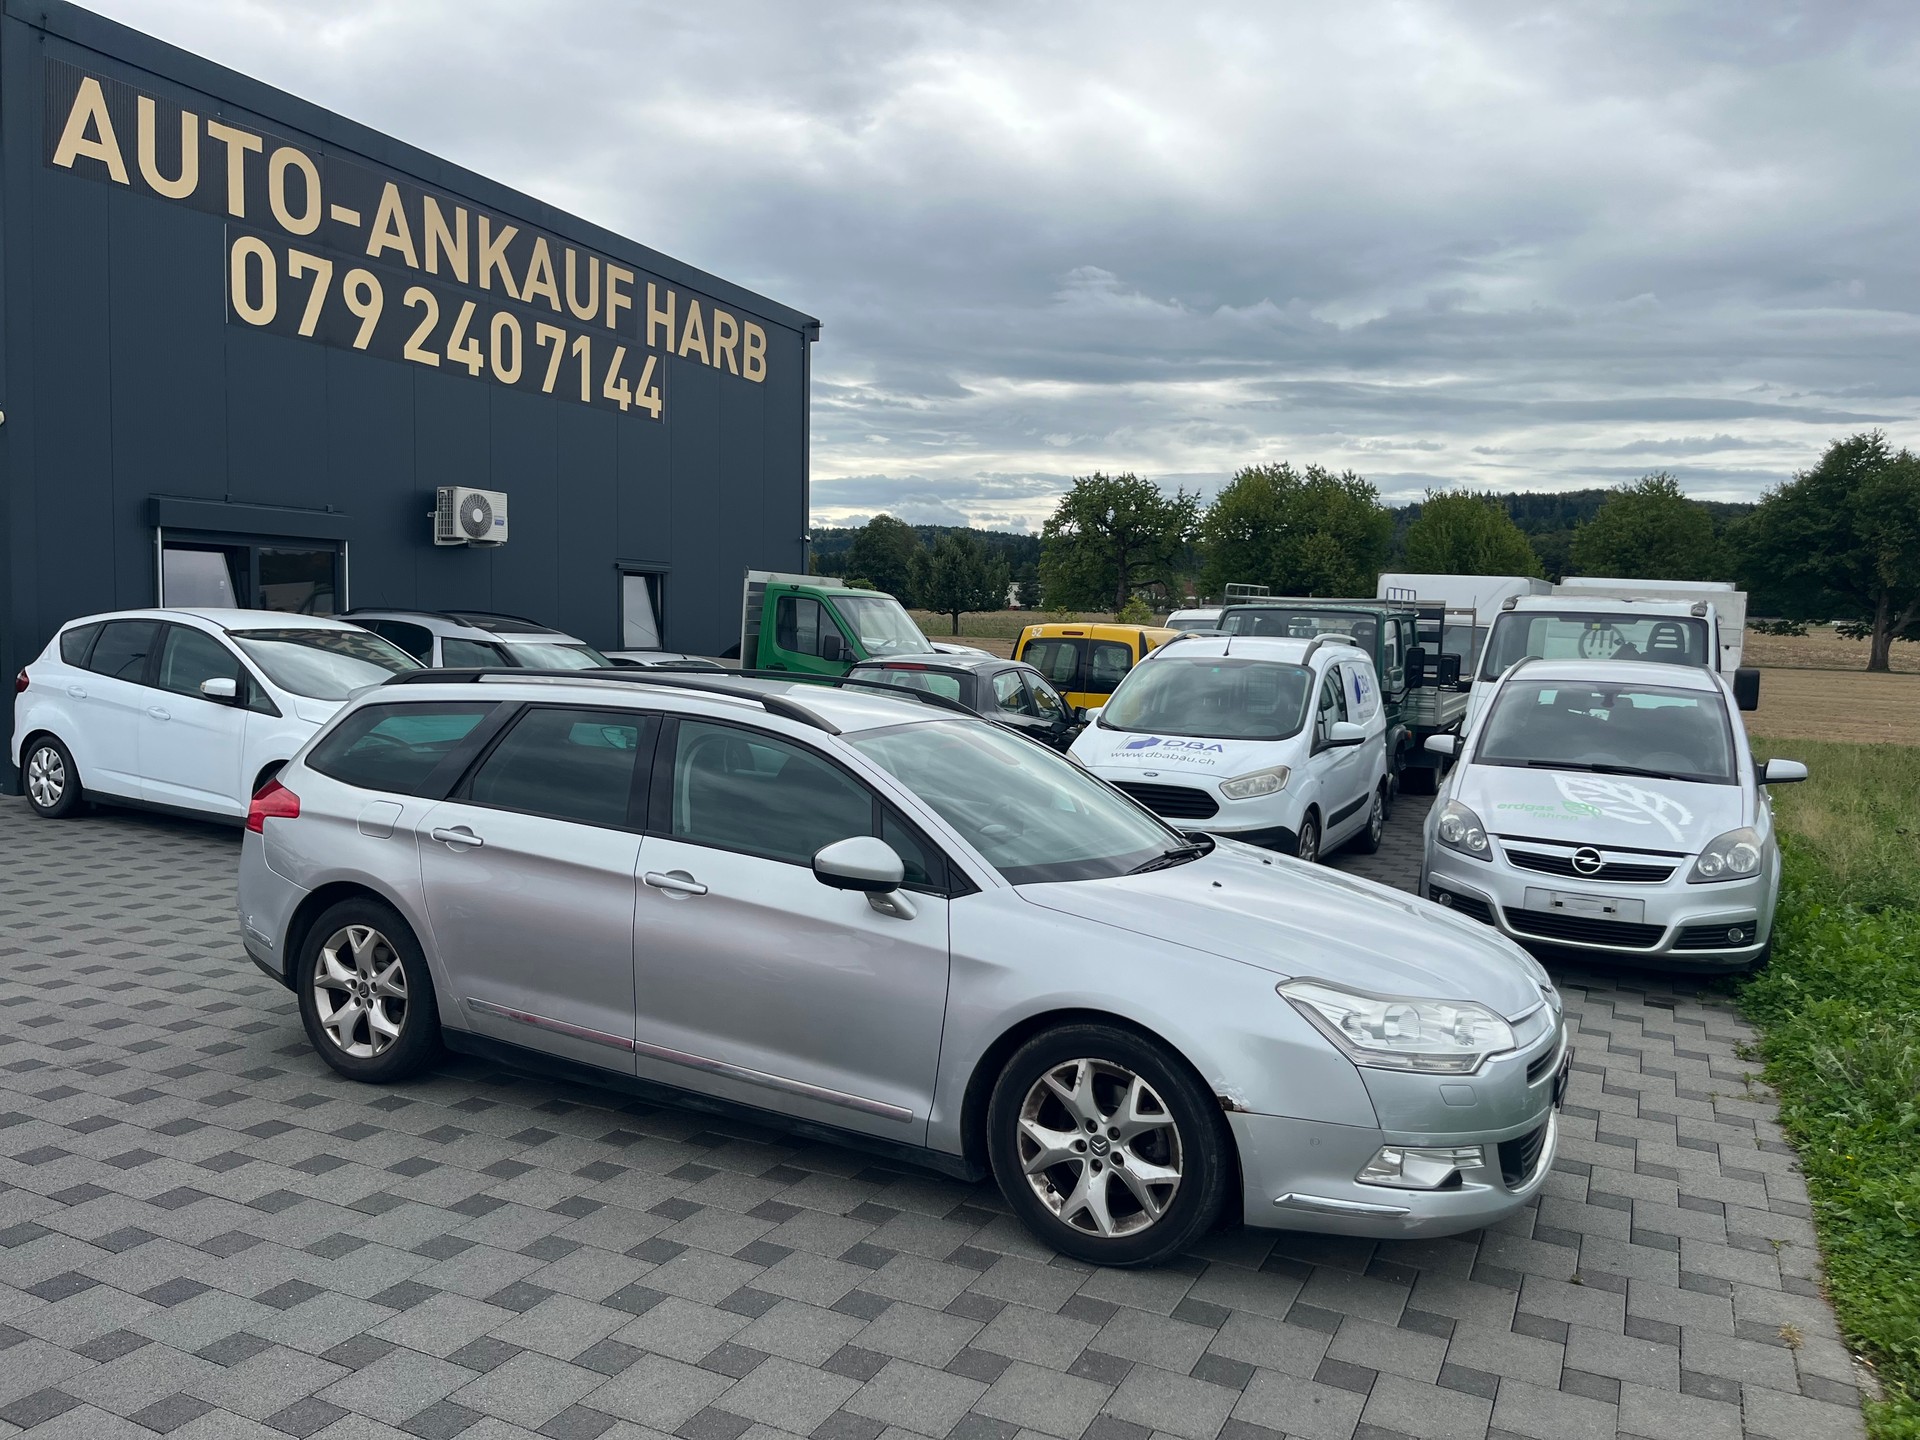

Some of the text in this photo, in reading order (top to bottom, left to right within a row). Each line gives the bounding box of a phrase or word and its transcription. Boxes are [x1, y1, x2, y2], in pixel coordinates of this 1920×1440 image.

[53, 76, 767, 384] AUTO-ANKAUF HARB
[230, 235, 385, 350] 079
[403, 286, 523, 385] 240
[1031, 627, 1043, 637] 52
[1162, 740, 1224, 753] DBA
[1111, 751, 1216, 765] www.dbabau.ch
[1497, 803, 1555, 811] erdgas
[1533, 810, 1579, 821] fahren
